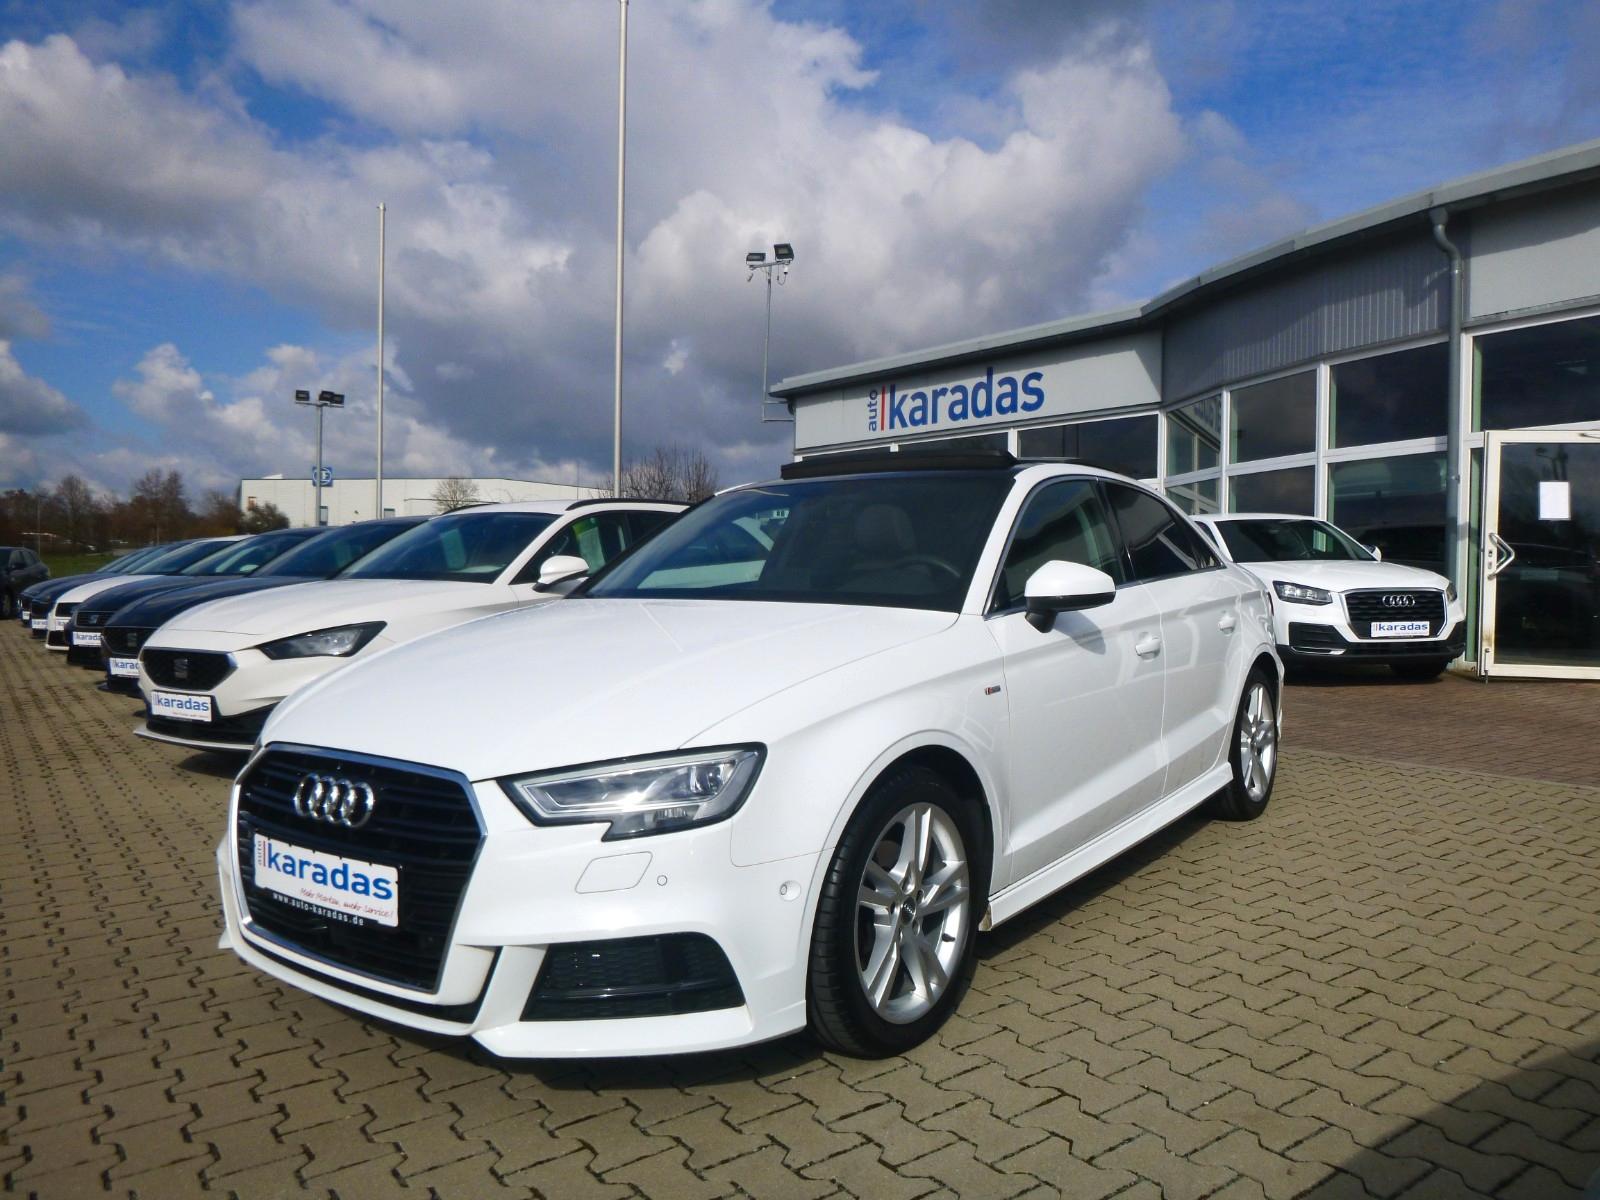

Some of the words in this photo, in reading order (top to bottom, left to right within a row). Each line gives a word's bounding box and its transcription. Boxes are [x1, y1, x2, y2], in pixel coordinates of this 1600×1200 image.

[867, 389, 878, 432] auto
[889, 366, 1045, 430] karadas
[1378, 622, 1428, 631] karadas
[157, 694, 209, 712] karadas
[267, 842, 393, 901] karadas
[272, 892, 364, 926] www.auto-karadas.de
